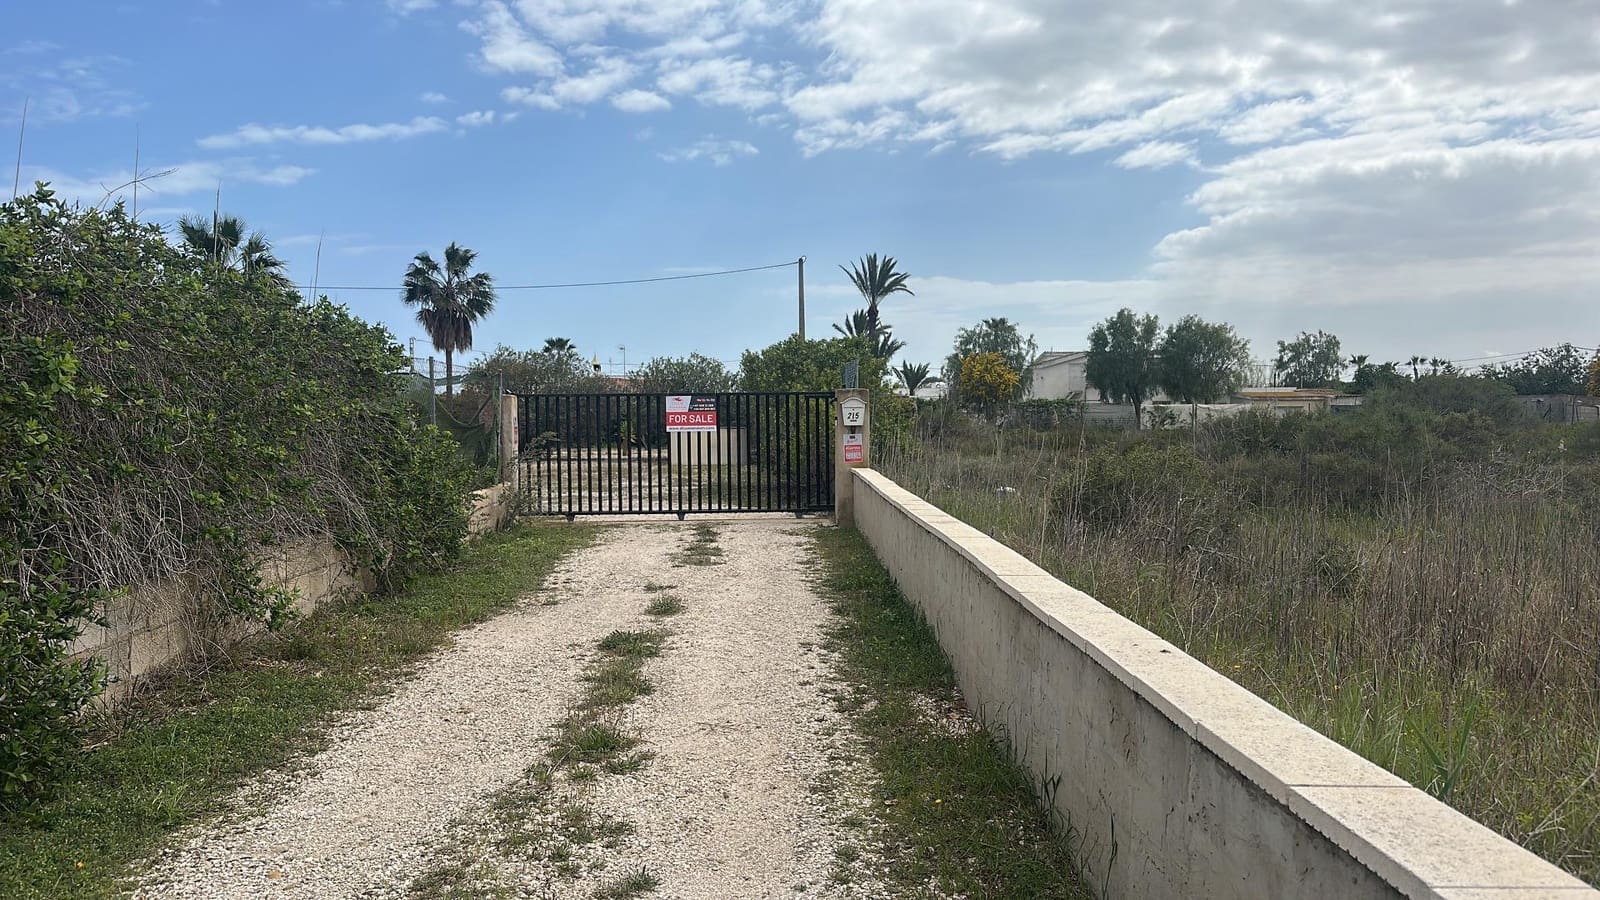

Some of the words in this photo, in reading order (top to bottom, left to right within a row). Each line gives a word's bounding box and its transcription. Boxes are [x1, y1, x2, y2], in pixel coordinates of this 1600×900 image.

[669, 415, 687, 423] FOR
[689, 415, 713, 423] SALE
[847, 412, 859, 420] 215
